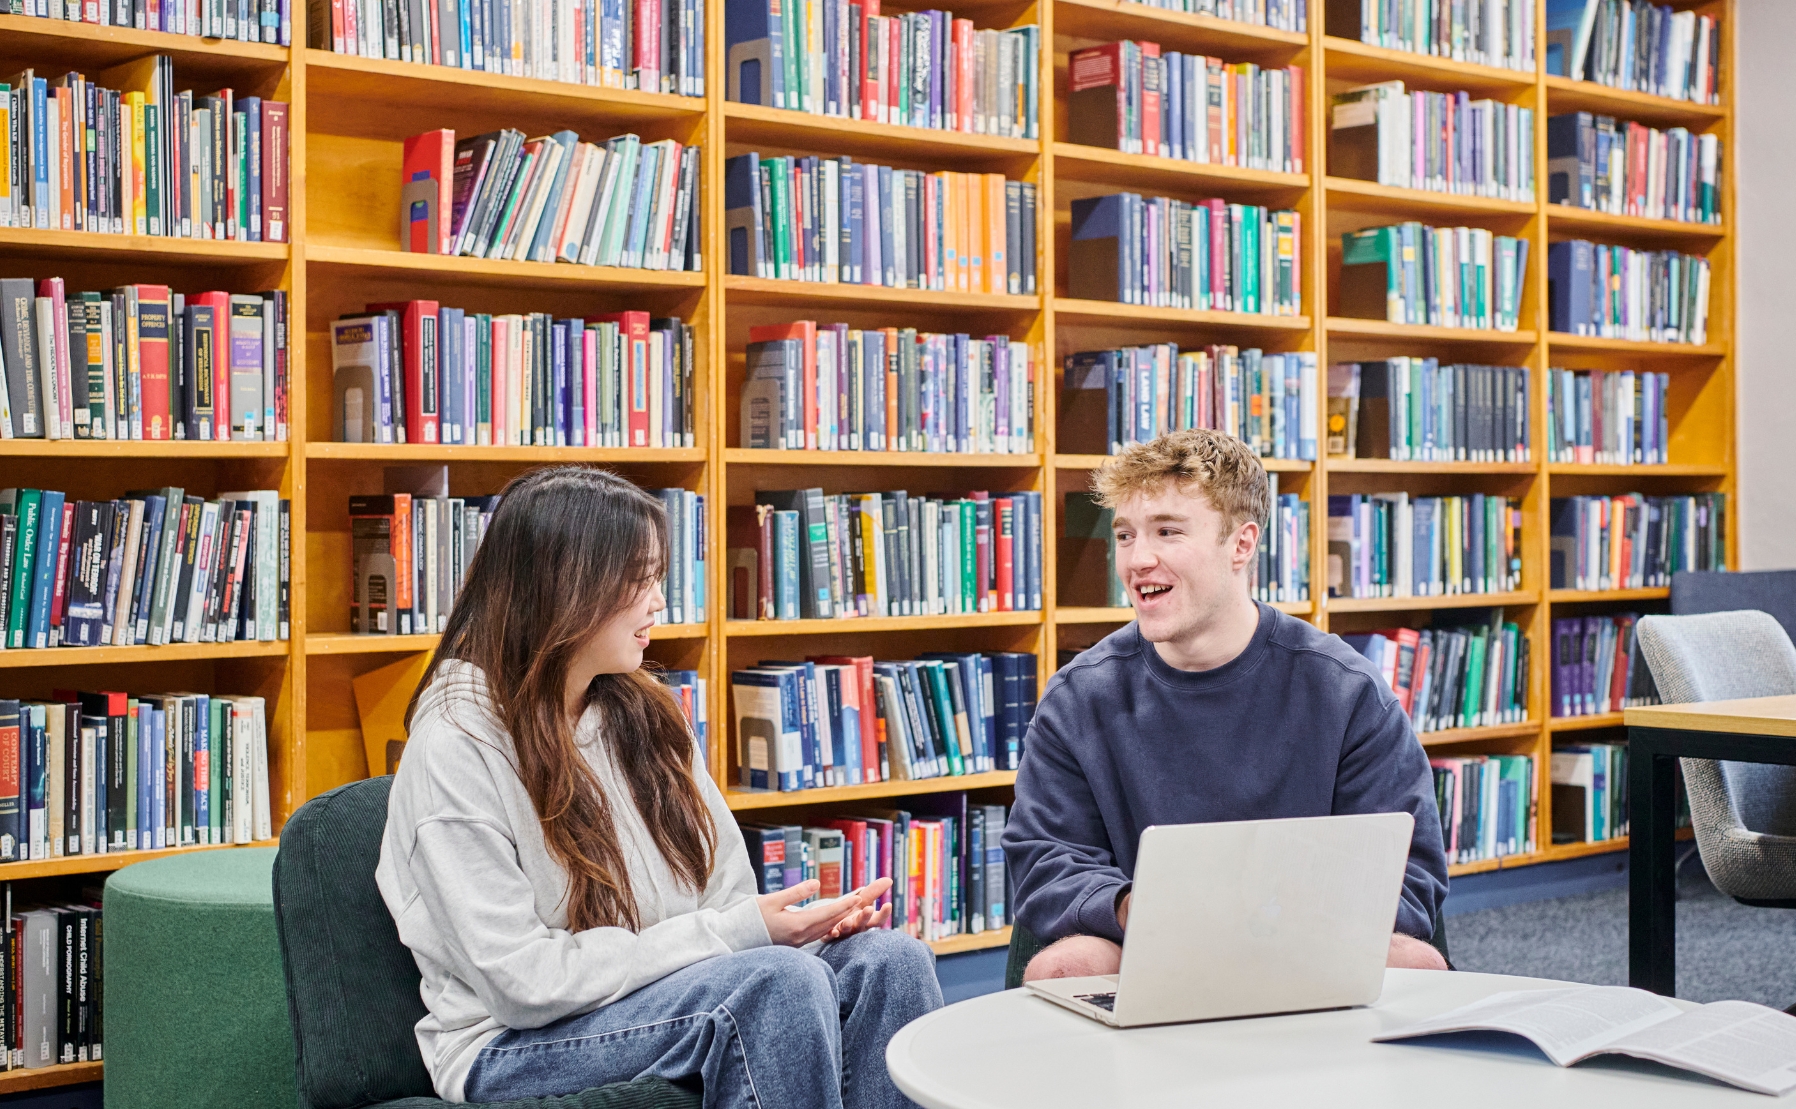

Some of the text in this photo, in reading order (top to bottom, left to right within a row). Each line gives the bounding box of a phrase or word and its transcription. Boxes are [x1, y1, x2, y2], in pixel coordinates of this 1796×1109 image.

[24, 353, 32, 367] AND
[25, 368, 33, 382] THE
[1140, 371, 1149, 430] LAND LAW
[21, 502, 37, 569] Public Order Law
[60, 541, 68, 554] Why
[200, 535, 210, 568] terrorism
[2, 732, 9, 745] OF
